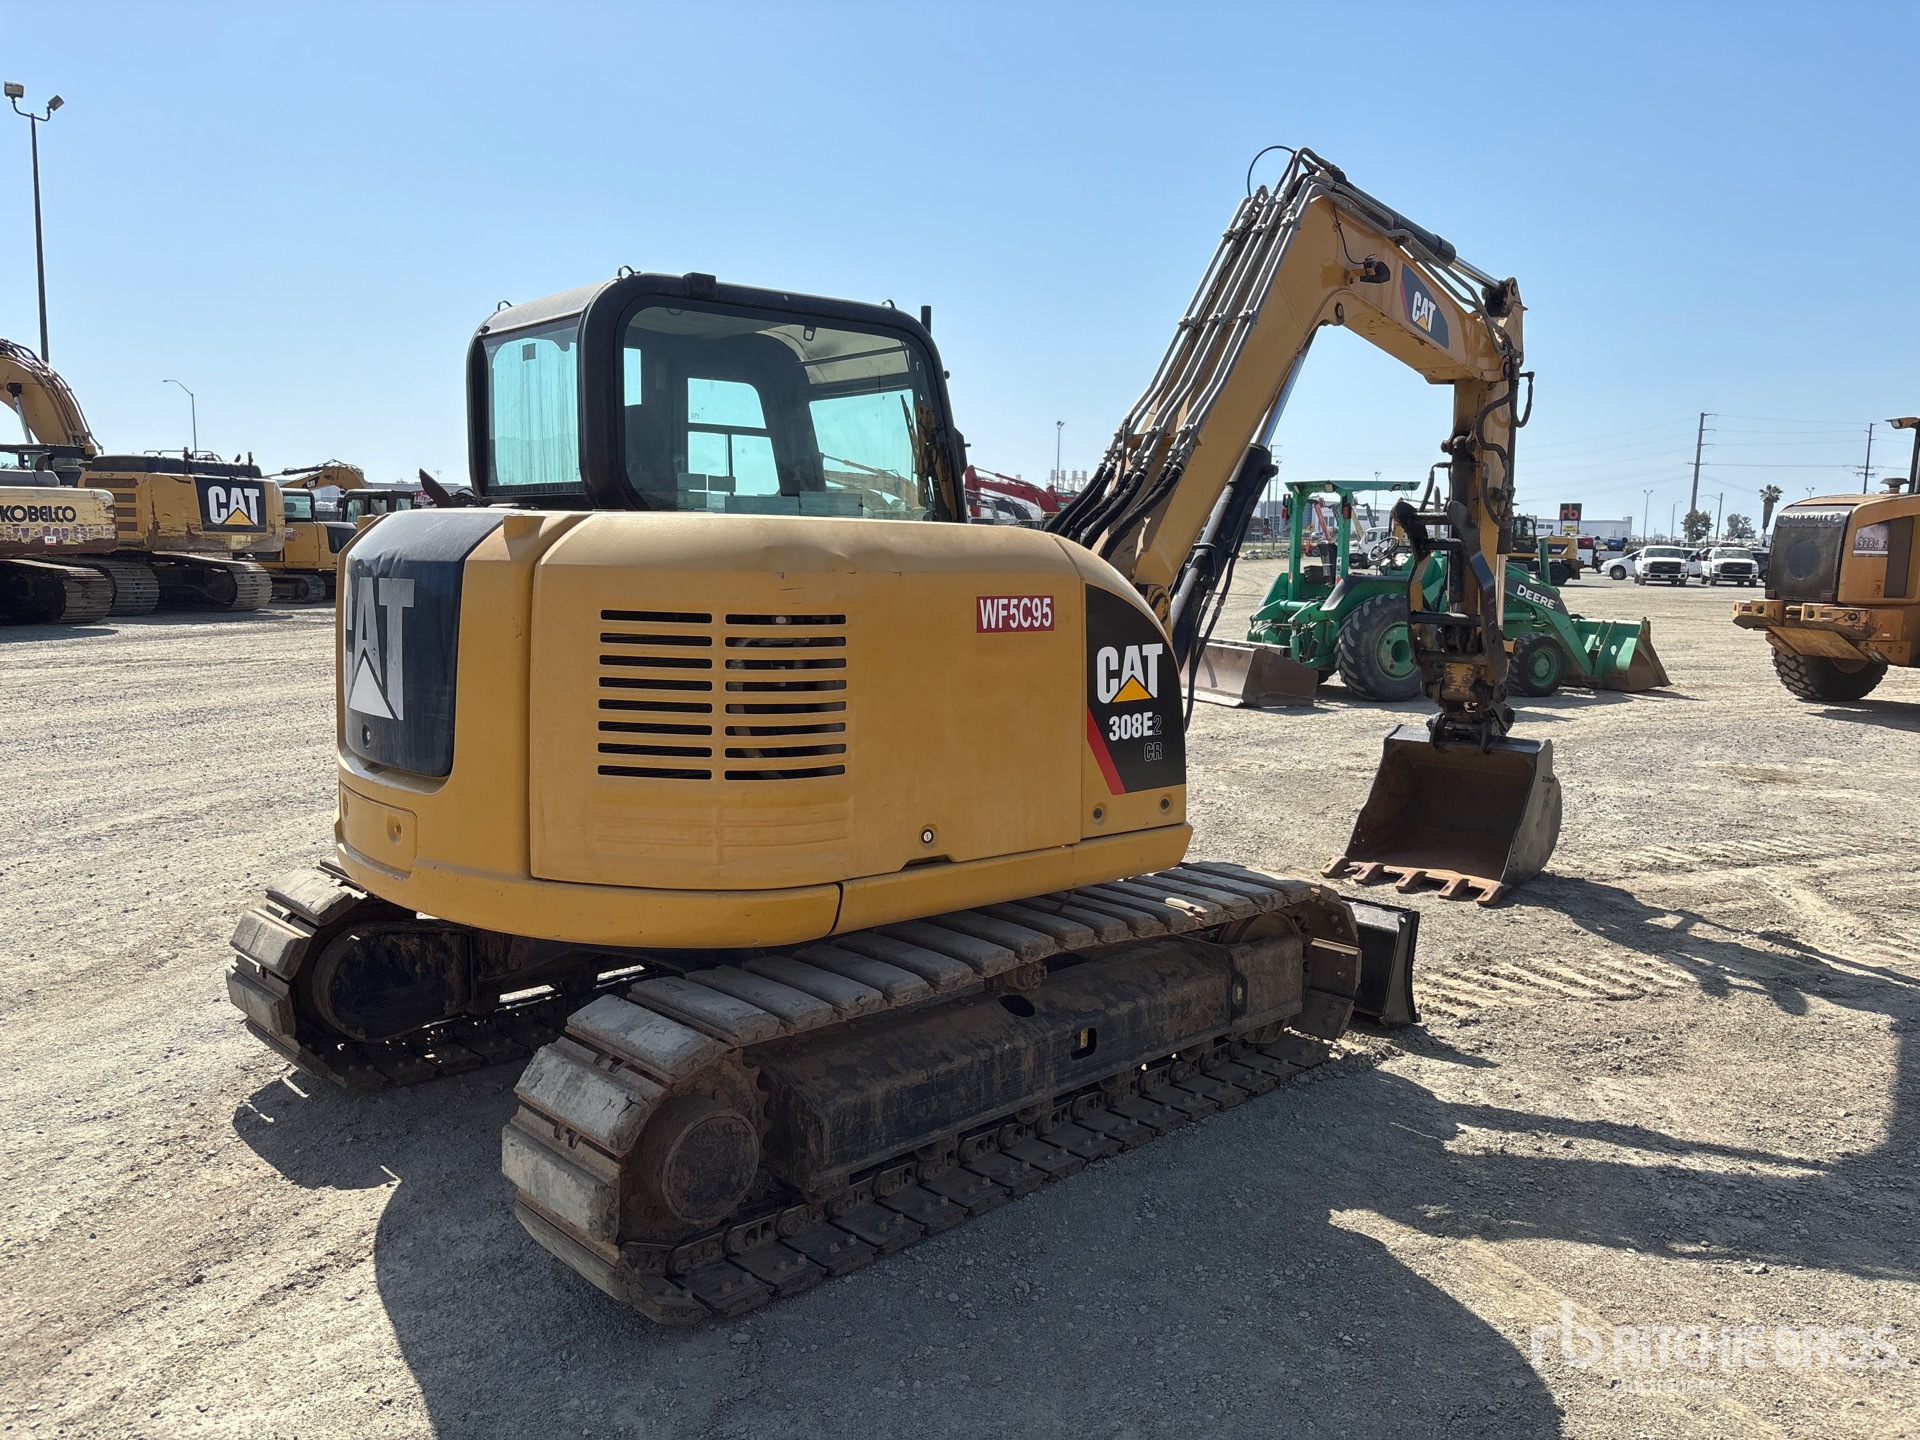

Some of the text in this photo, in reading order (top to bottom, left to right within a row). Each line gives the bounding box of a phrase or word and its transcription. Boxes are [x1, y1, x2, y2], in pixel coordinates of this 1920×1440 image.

[1412, 291, 1436, 333] CAT
[0, 505, 77, 523] KOBELCO
[208, 486, 260, 526] CAT
[1516, 583, 1556, 610] DEERE
[979, 597, 1052, 630] WF5C95
[1096, 643, 1163, 704] CAT
[1143, 742, 1163, 762] CR
